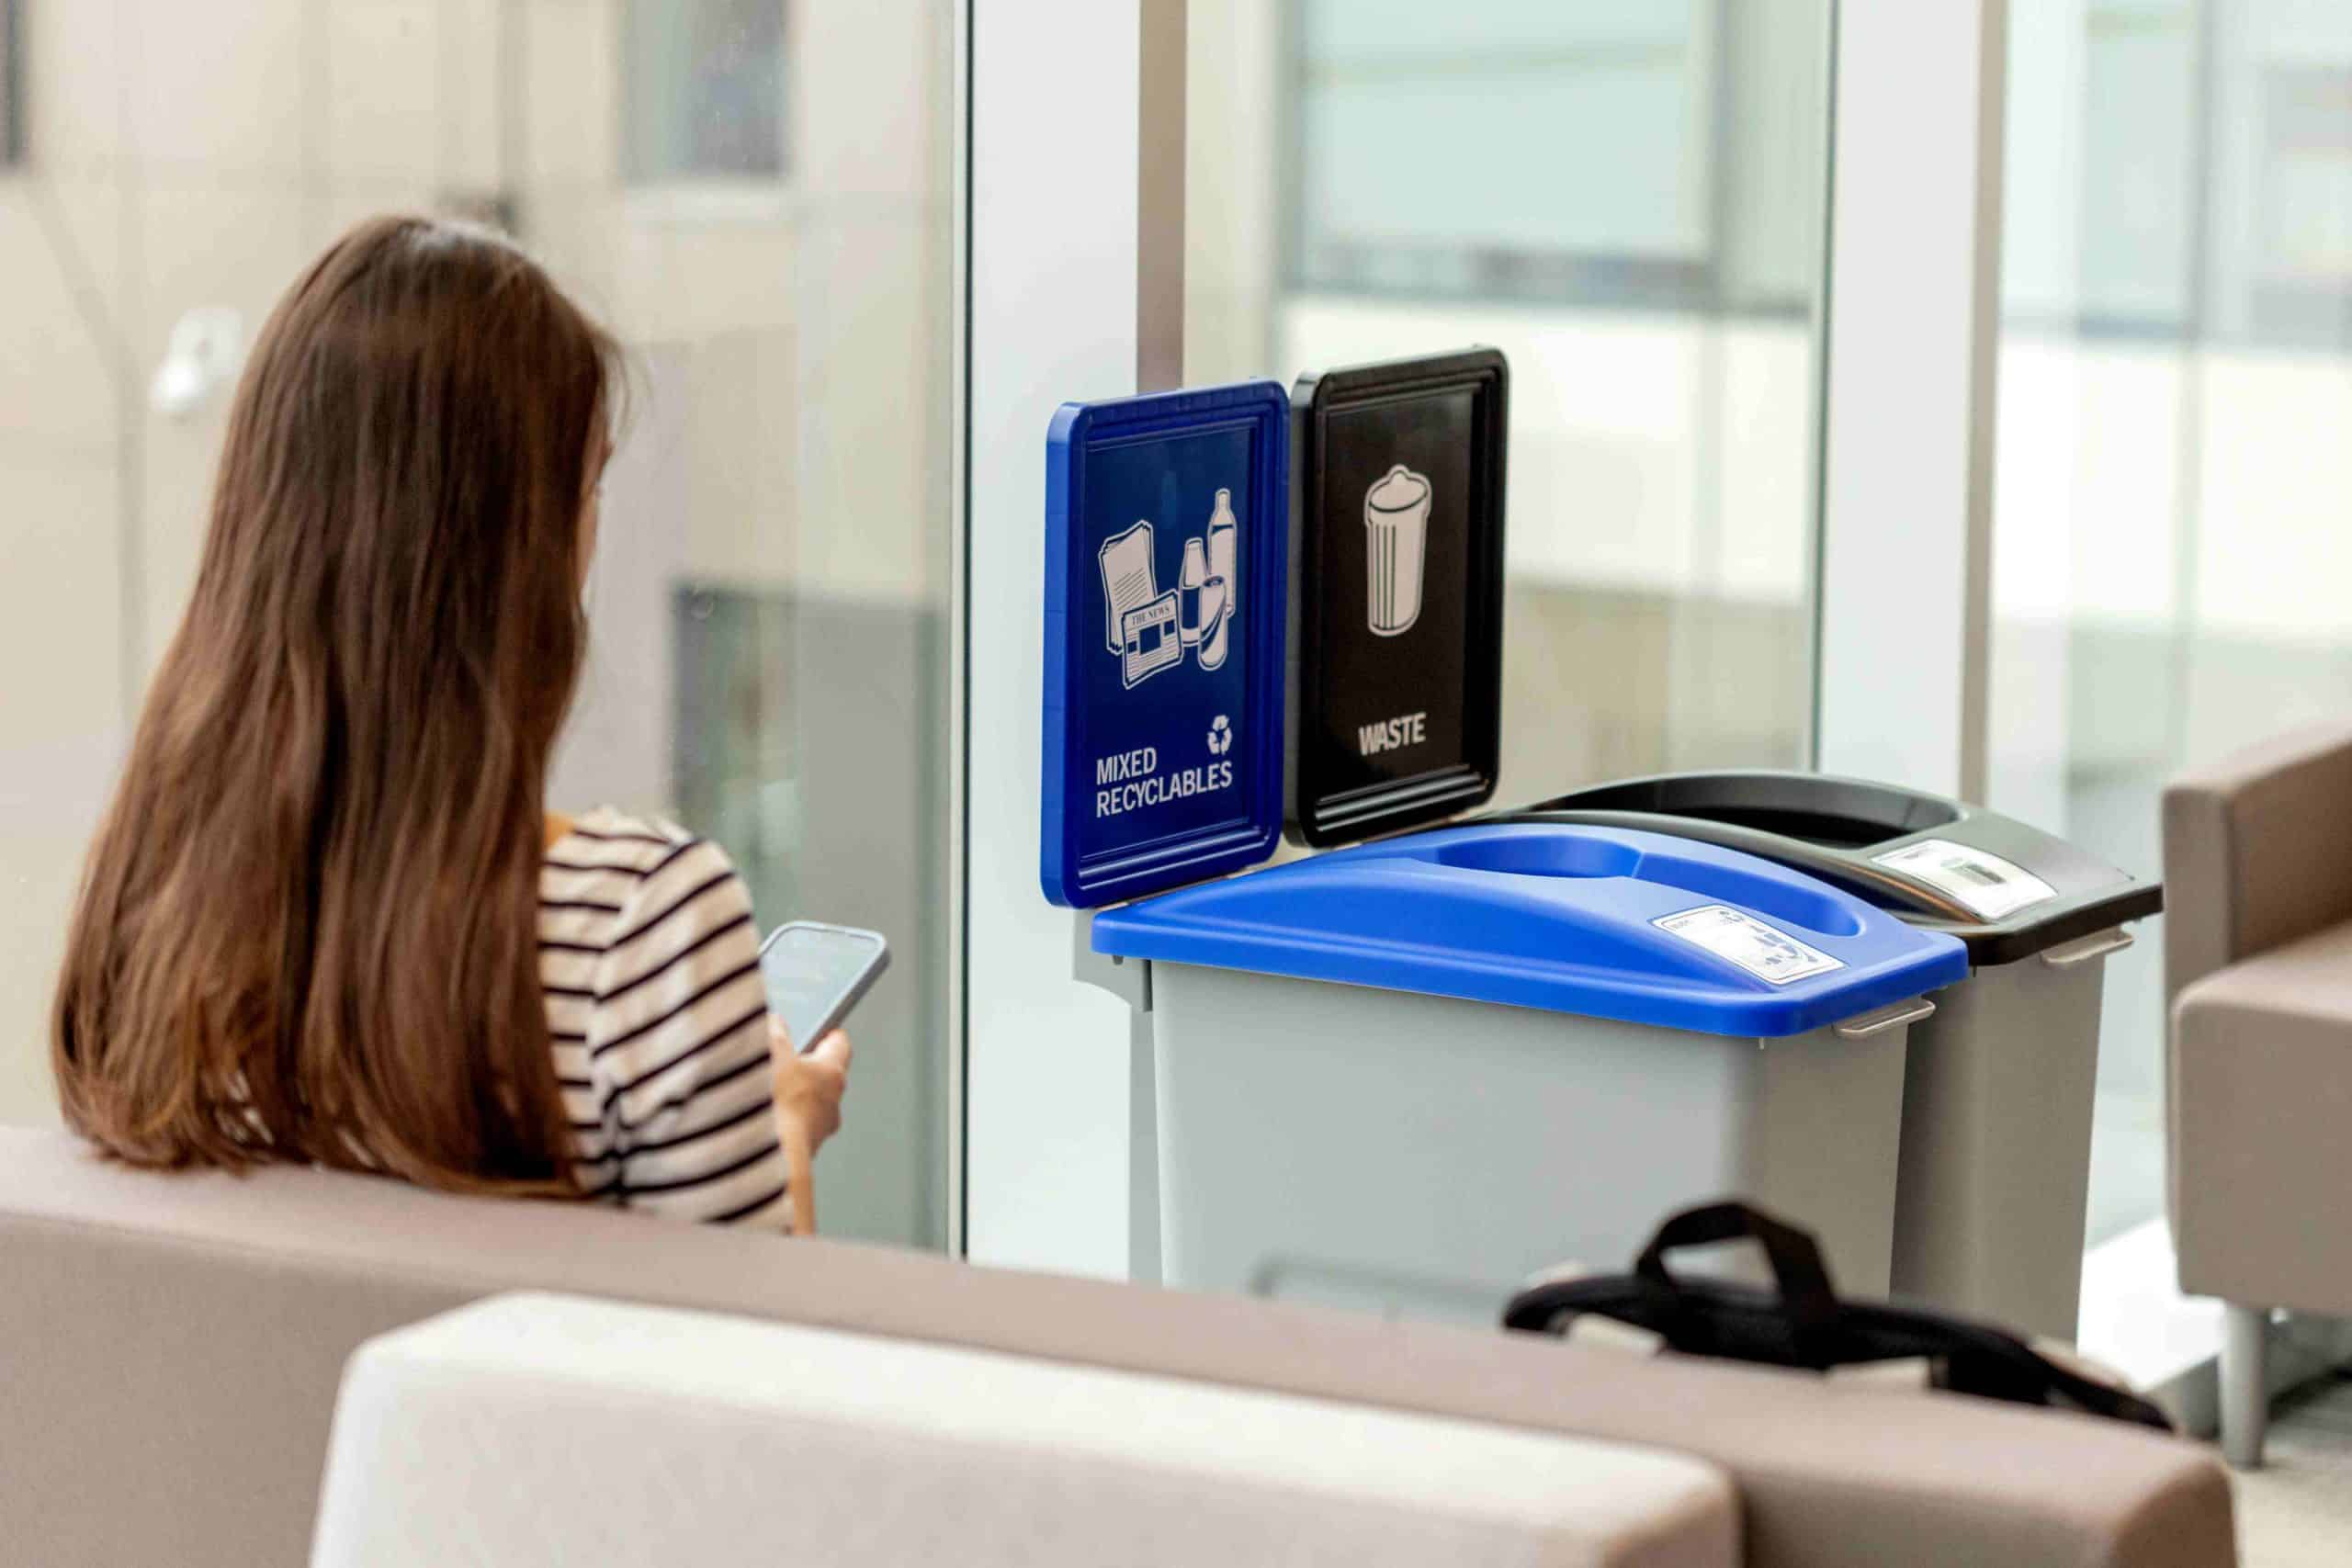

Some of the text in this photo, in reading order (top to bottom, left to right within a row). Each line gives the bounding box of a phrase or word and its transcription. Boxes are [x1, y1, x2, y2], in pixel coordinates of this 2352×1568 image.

[1131, 604, 1170, 626] THE NEWS
[1358, 712, 1427, 755] WASTE
[1096, 747, 1157, 785] MIXED
[1096, 761, 1233, 818] RECYCLABLES
